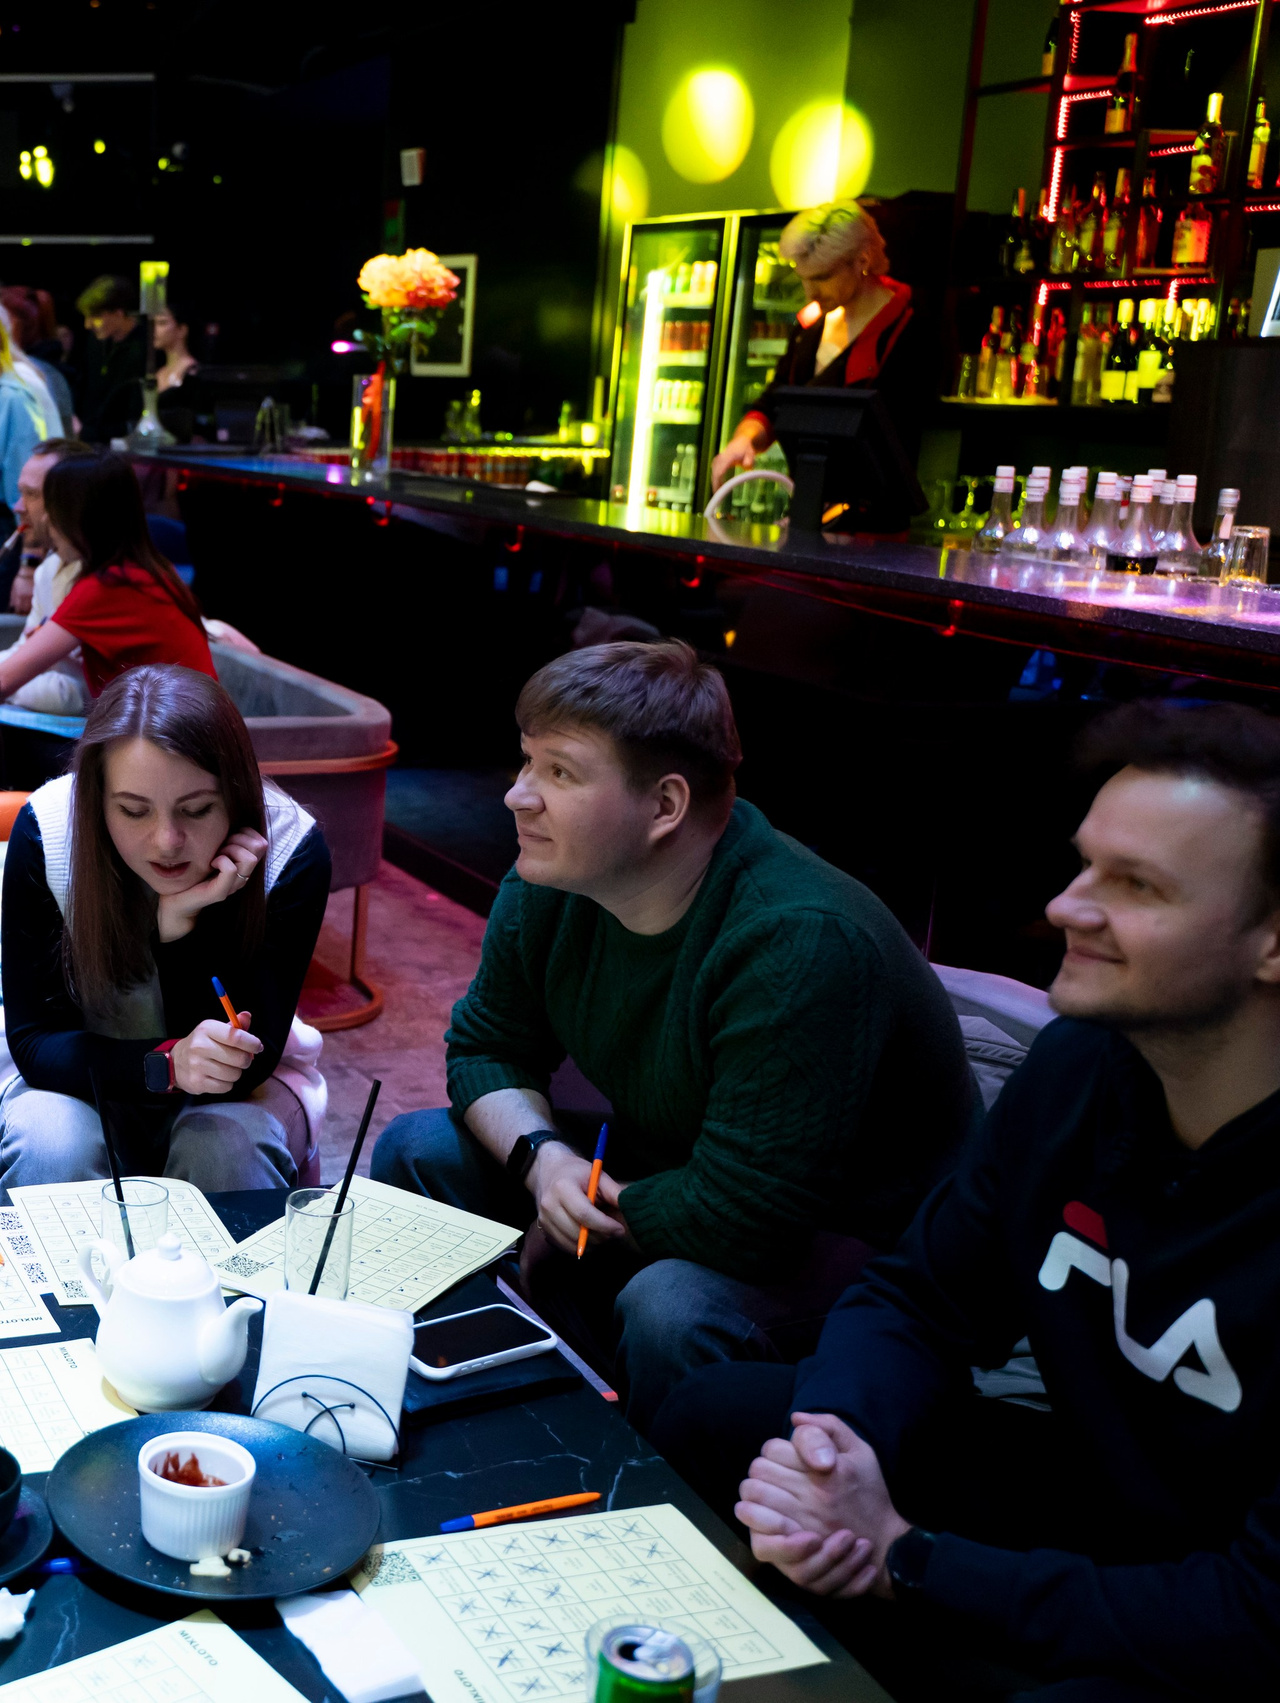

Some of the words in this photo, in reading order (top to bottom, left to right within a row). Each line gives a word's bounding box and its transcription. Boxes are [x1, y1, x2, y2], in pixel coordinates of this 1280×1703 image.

[1038, 1201, 1243, 1413] FILA
[60, 1346, 78, 1369] MIXLOTO
[179, 1629, 218, 1667] MIXLOTO
[454, 1669, 486, 1703] IXLOTO
